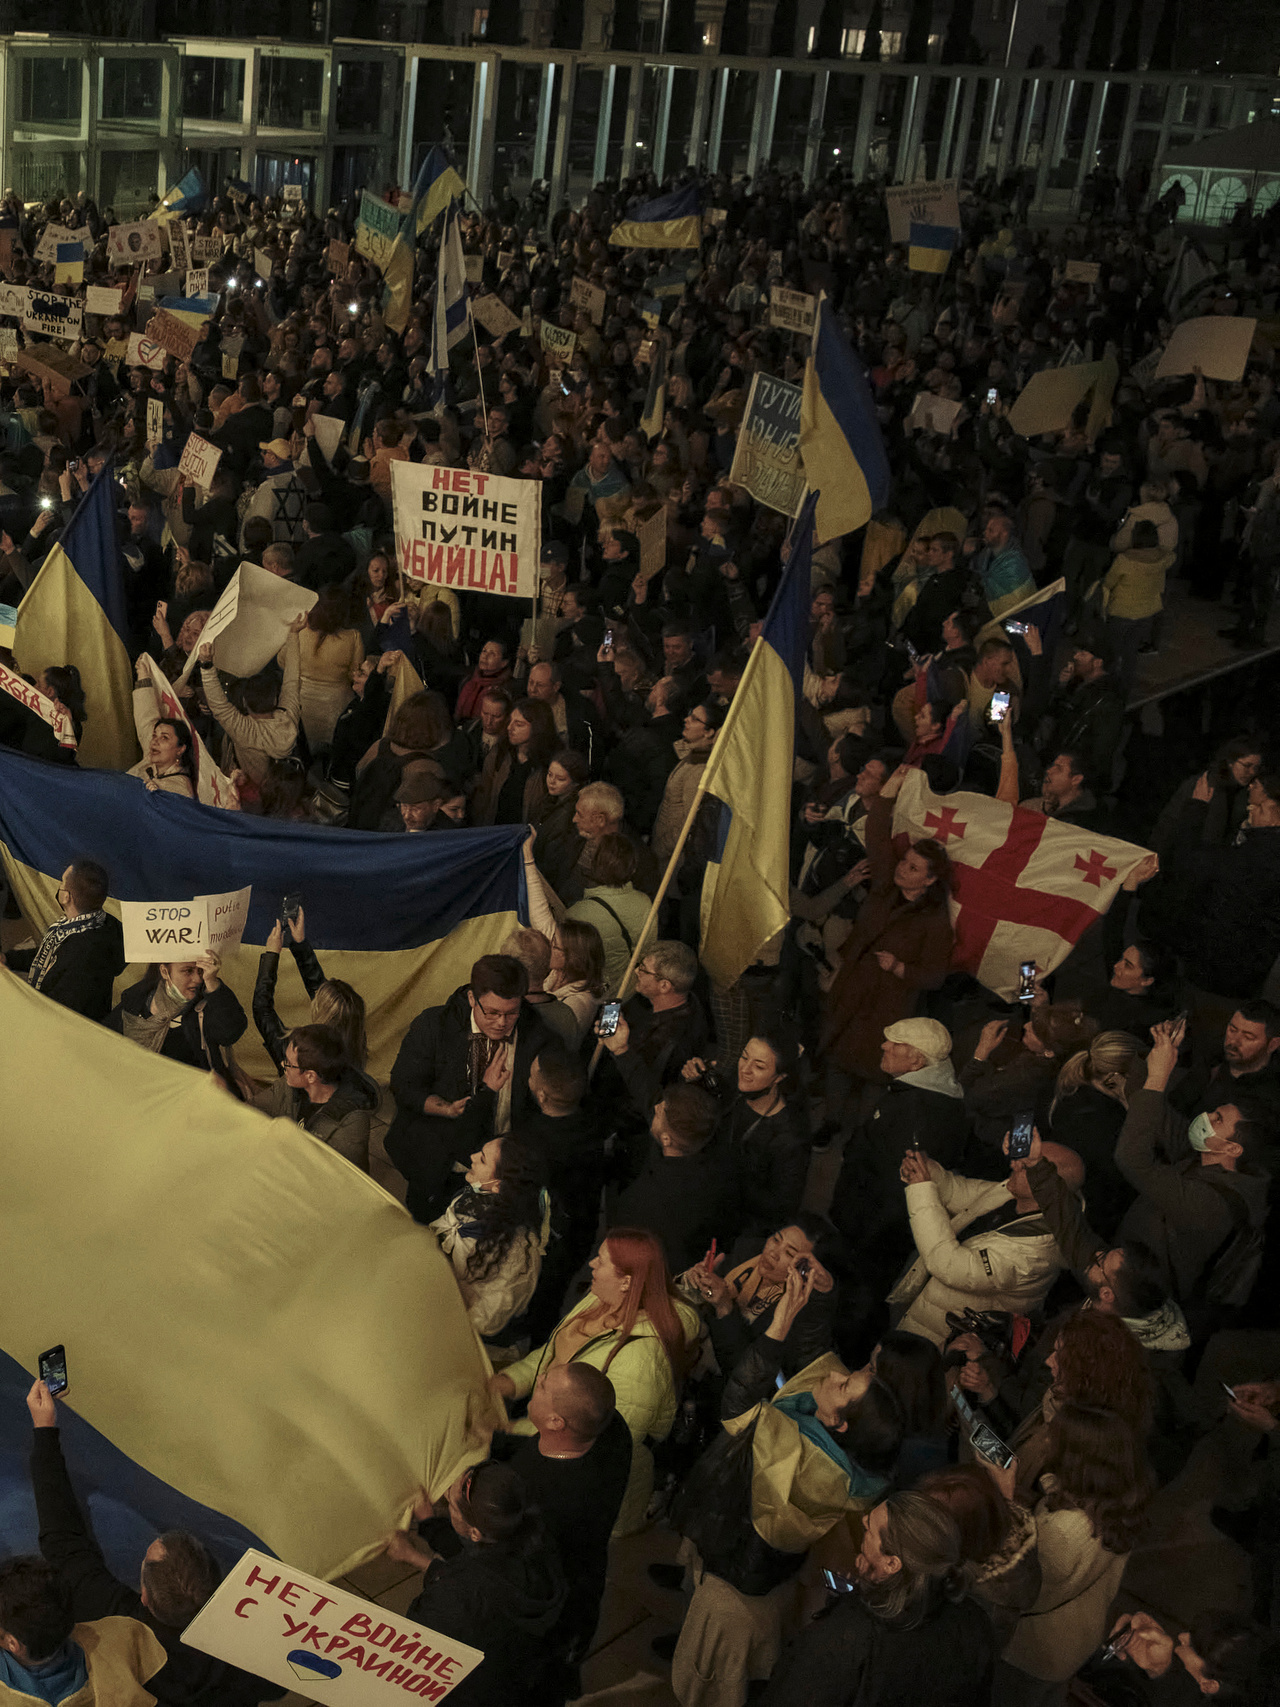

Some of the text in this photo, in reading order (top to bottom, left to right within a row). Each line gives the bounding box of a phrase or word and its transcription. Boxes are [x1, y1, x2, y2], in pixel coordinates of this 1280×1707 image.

[200, 240, 218, 249] STOP
[27, 290, 58, 304] STOP
[41, 324, 66, 336] FIRE!
[432, 468, 489, 495] НЕТ
[422, 491, 517, 525] ВОЙНЕ
[422, 519, 517, 552] ПУТИН
[400, 535, 518, 593] УБИЙЦА!
[145, 907, 191, 922] STOP
[146, 921, 202, 944] WAR!
[244, 1565, 463, 1681] НЕТ ВОЙНЕ
[234, 1597, 454, 1702] С УКРАИНОЙ
